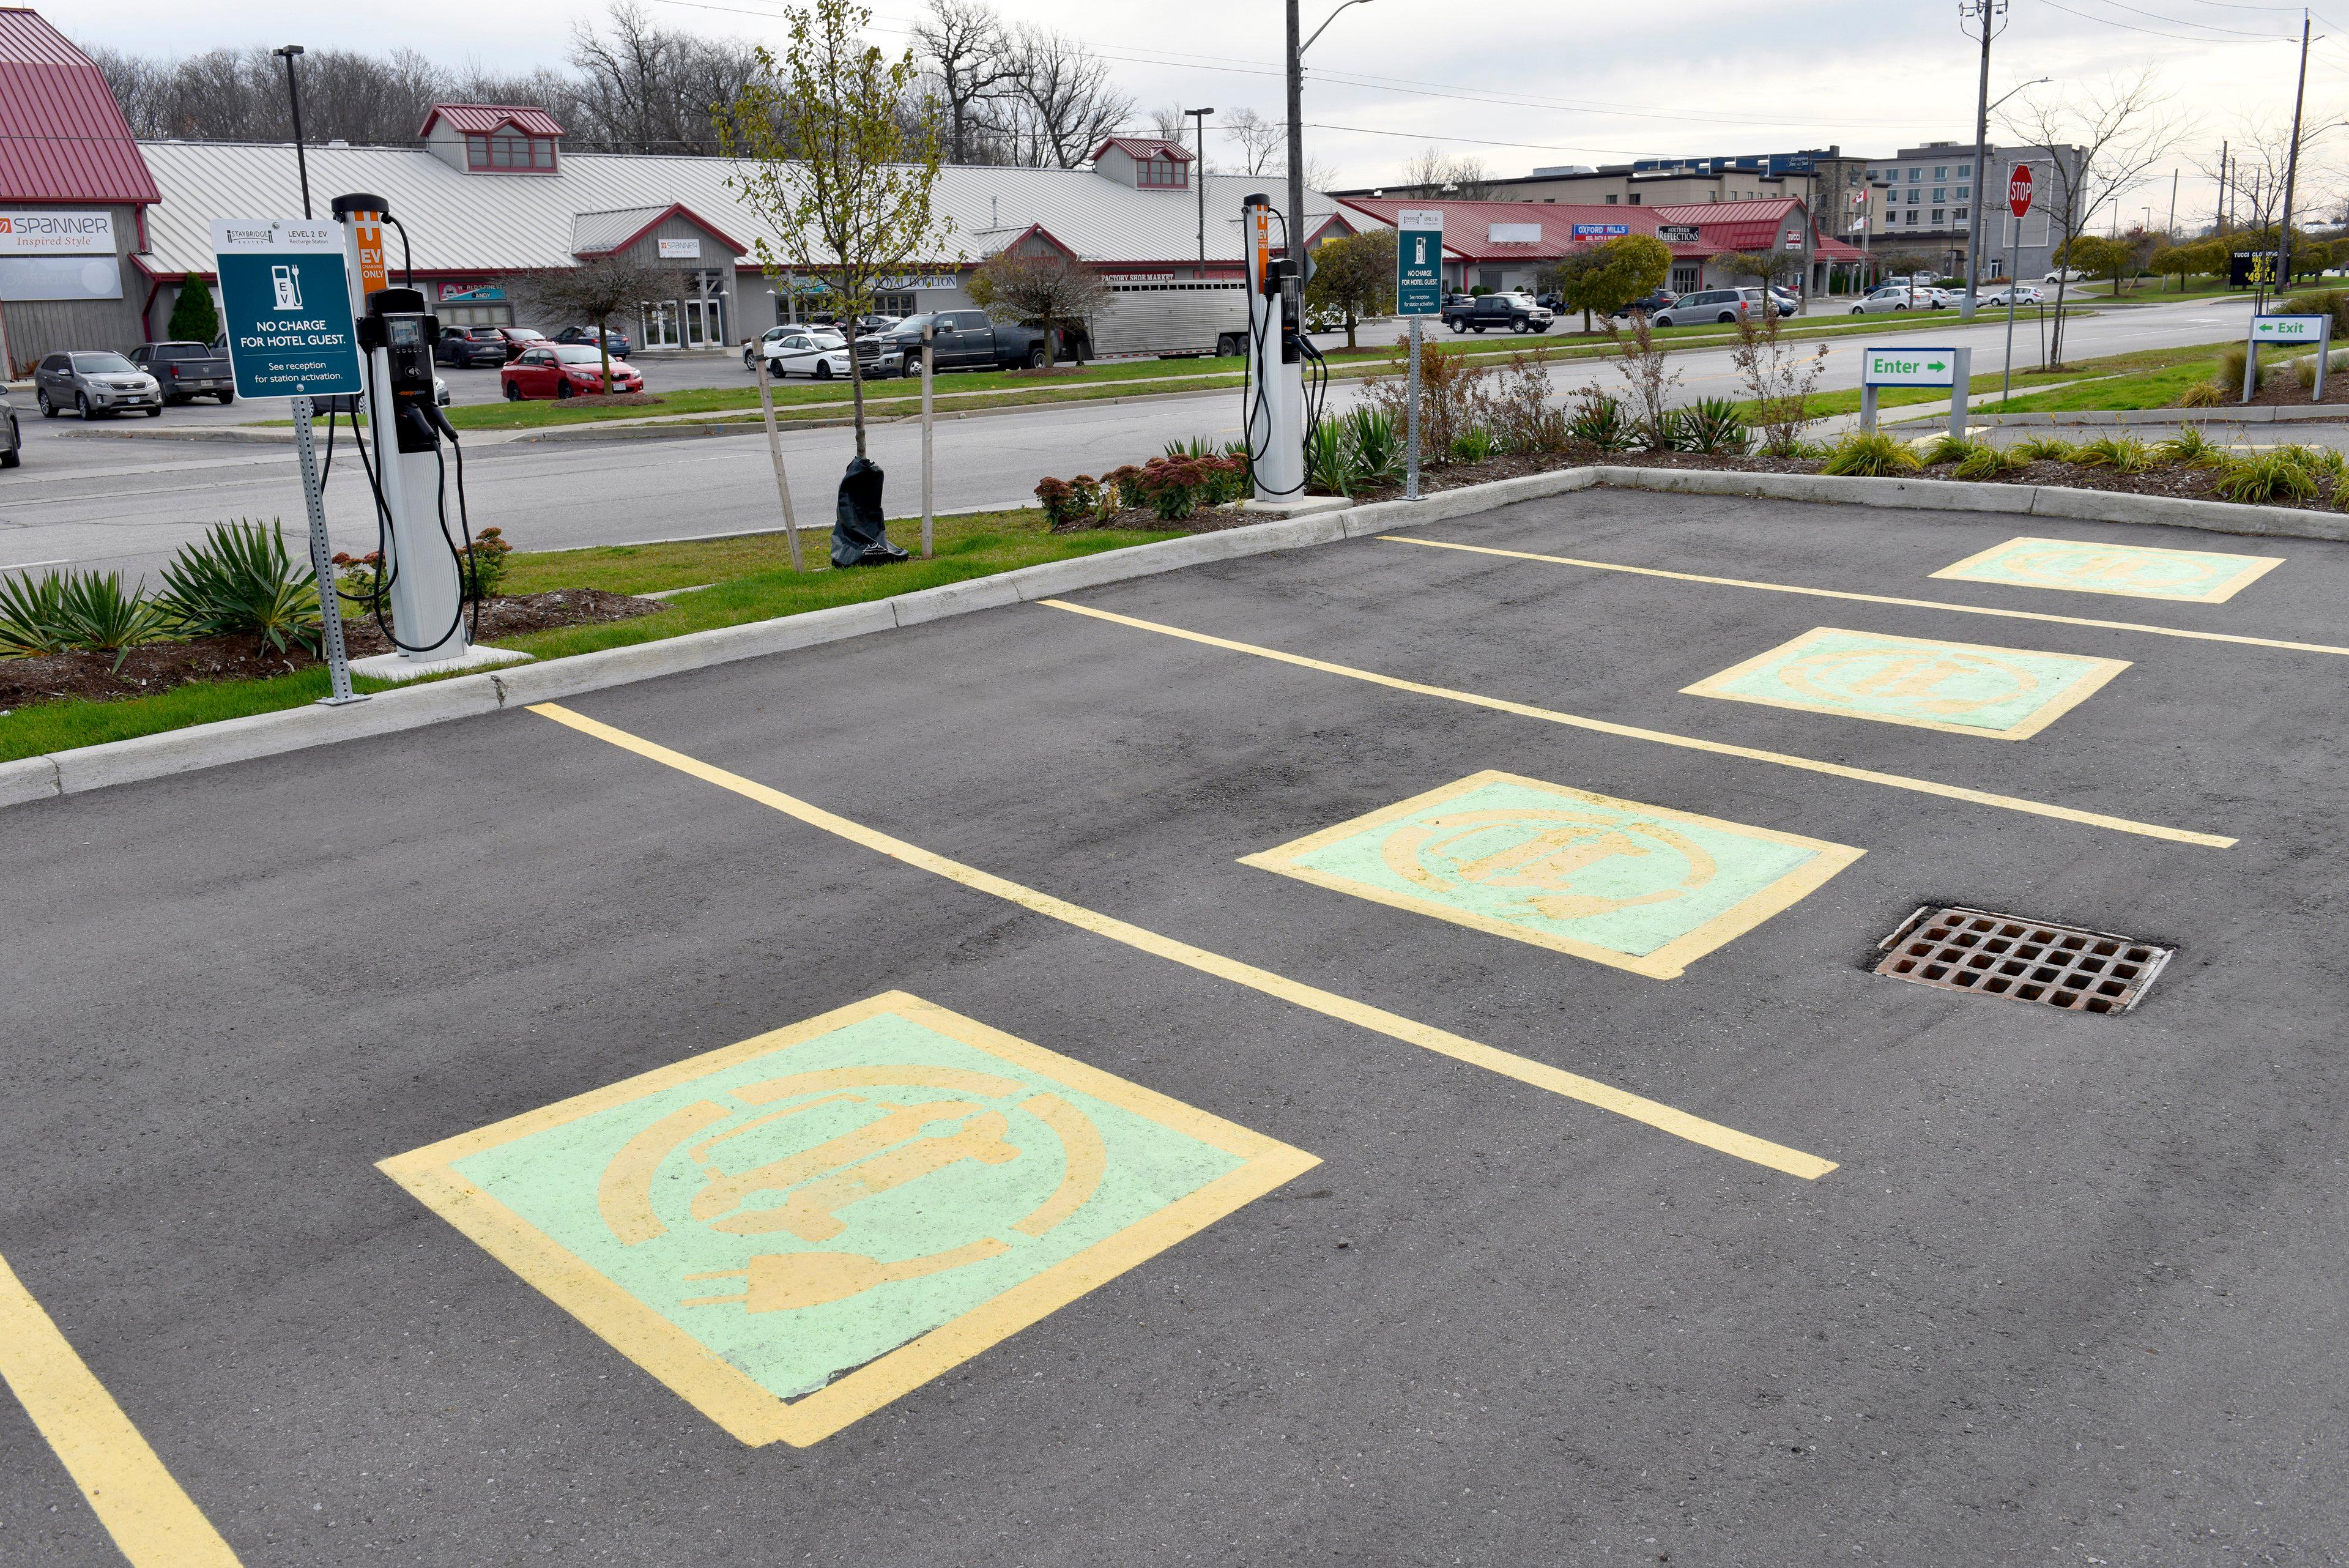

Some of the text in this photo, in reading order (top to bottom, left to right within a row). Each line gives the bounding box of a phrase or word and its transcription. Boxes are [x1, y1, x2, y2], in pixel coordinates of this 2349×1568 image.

[2011, 181, 2032, 201] STOP
[1258, 229, 1267, 239] EV
[1659, 231, 1699, 240] REFLECTIONS
[17, 236, 61, 248] Inspired
[360, 248, 381, 263] EV
[363, 270, 384, 278] ONLY
[875, 276, 956, 288] ROYAL DOULTON
[256, 320, 327, 332] NO CHARGE
[2278, 322, 2304, 333] Exit
[240, 334, 346, 347] FOR HOTEL GUEST.
[269, 362, 327, 371] See reception
[1874, 359, 1920, 374] Enter
[254, 372, 343, 384] for station activation.
